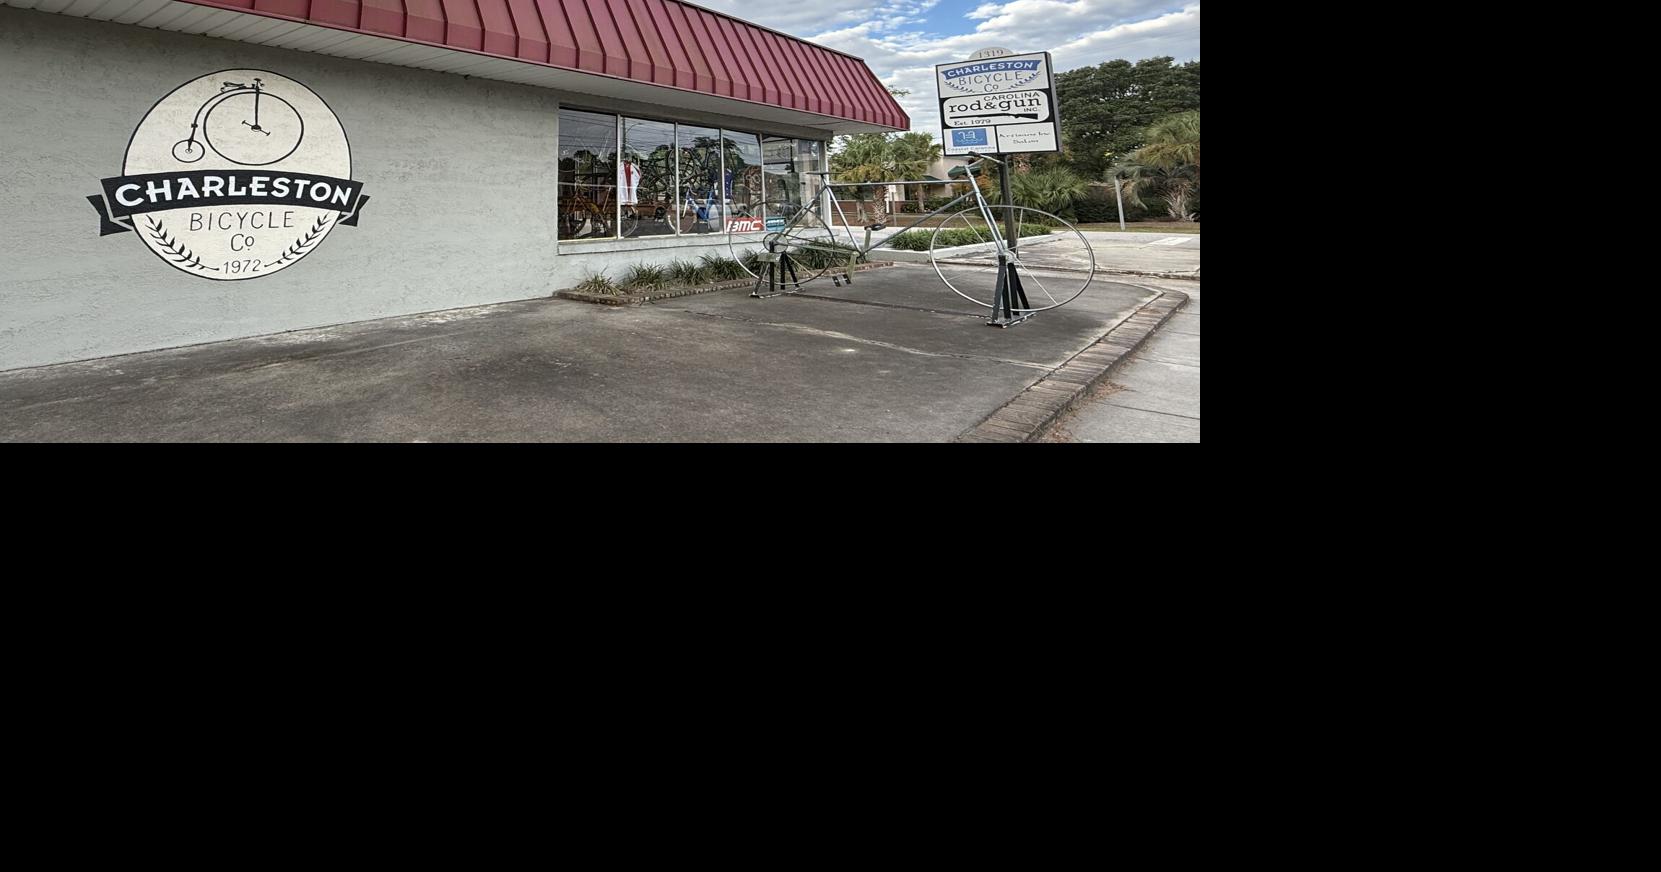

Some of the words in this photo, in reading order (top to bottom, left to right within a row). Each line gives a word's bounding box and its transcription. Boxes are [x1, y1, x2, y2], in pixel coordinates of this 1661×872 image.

[979, 49, 1004, 59] 1319
[947, 61, 1033, 77] CHARLESTON
[958, 71, 1023, 86] BICYCLE
[983, 83, 999, 93] Co
[983, 91, 1041, 102] CAROLINA
[948, 97, 1042, 113] rod&gun
[115, 175, 353, 207] CHARLESTON
[189, 211, 295, 231] BICYCLE
[726, 219, 762, 232] BMC
[230, 233, 255, 252] Co
[222, 259, 262, 274] 1972
